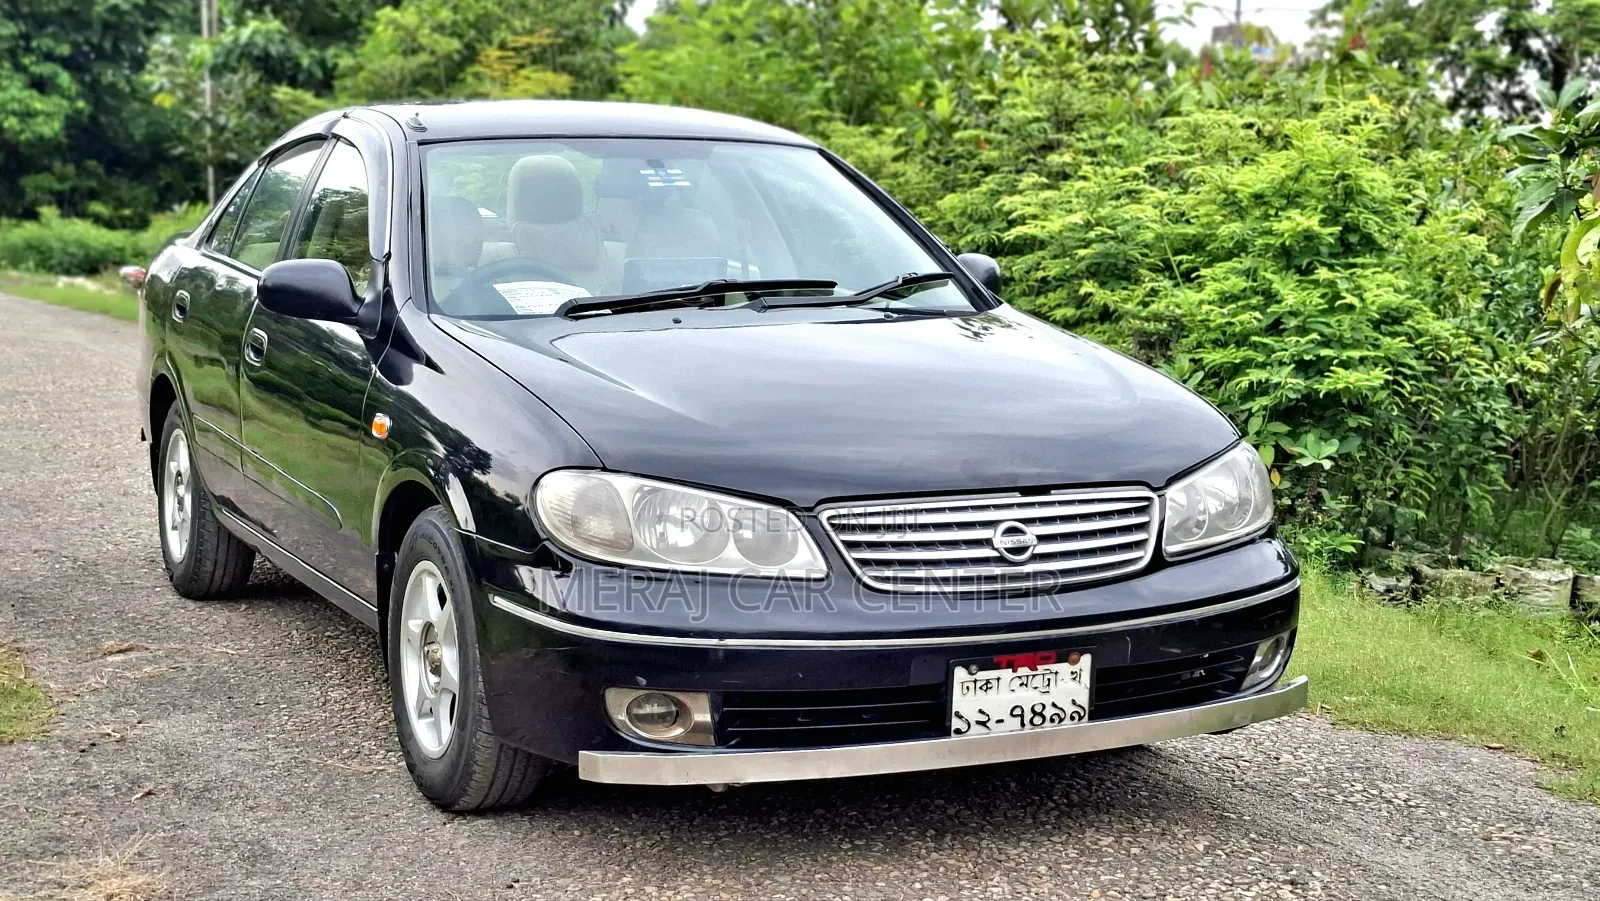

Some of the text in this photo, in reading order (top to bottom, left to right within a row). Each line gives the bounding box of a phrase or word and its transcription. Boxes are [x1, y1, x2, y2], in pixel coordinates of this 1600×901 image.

[999, 537, 1036, 546] NISSAN
[960, 676, 1001, 697] ঢাকা
[952, 698, 1087, 735] ১২-৭৪৯৯
